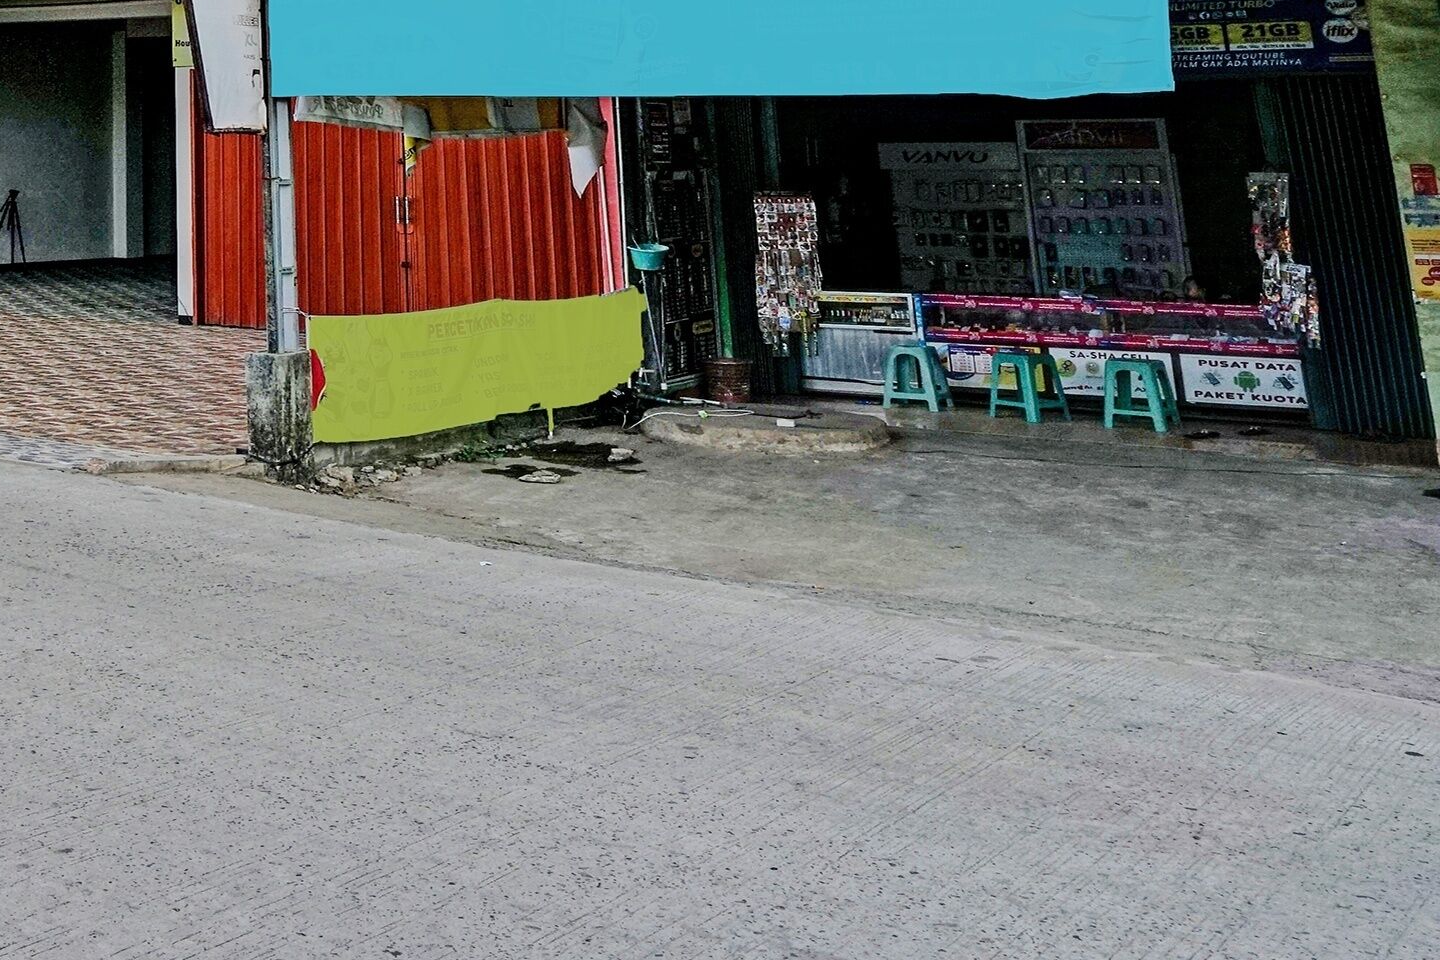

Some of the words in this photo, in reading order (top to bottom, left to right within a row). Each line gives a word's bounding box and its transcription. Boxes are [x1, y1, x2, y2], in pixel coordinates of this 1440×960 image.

[1228, 0, 1275, 9] TURBO
[1241, 23, 1301, 38] 21GB
[1326, 24, 1355, 37] iflix
[1202, 60, 1223, 68] GAK
[1226, 59, 1249, 67] ADA
[1251, 58, 1302, 67] MATINYA
[1235, 52, 1285, 61] YOUTUBE
[901, 148, 989, 165] VANVU
[1198, 359, 1249, 369] PUSAT
[1255, 362, 1297, 372] DATA
[1194, 390, 1245, 400] PAKET
[1251, 393, 1307, 405] KUOTA
